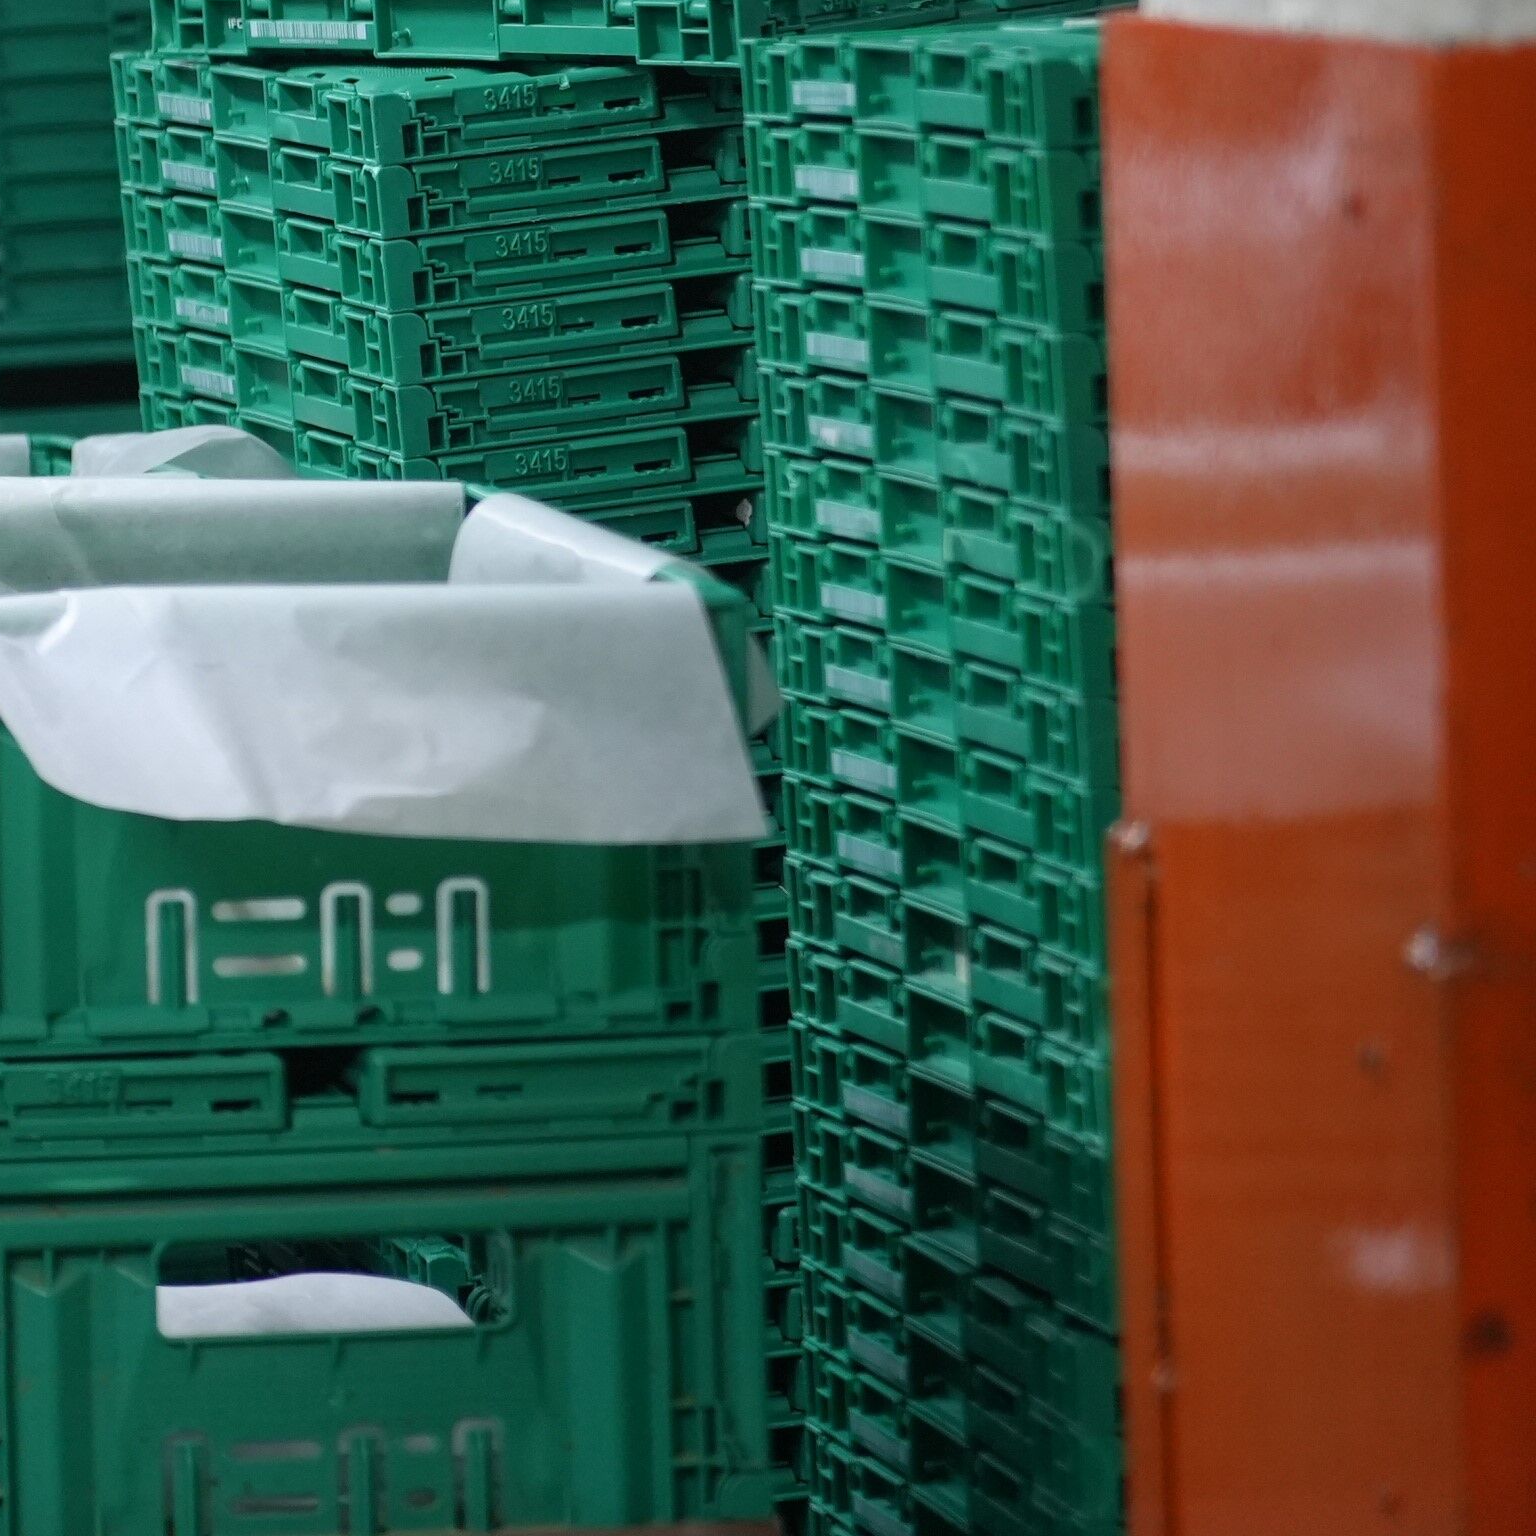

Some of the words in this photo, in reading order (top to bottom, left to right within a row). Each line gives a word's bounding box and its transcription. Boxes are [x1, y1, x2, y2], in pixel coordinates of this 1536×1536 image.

[484, 83, 537, 111] 3415
[489, 157, 539, 185] 3415
[495, 230, 548, 258] 3415
[502, 303, 554, 331] 3415
[509, 375, 561, 404] 3415
[515, 447, 568, 476] 3415
